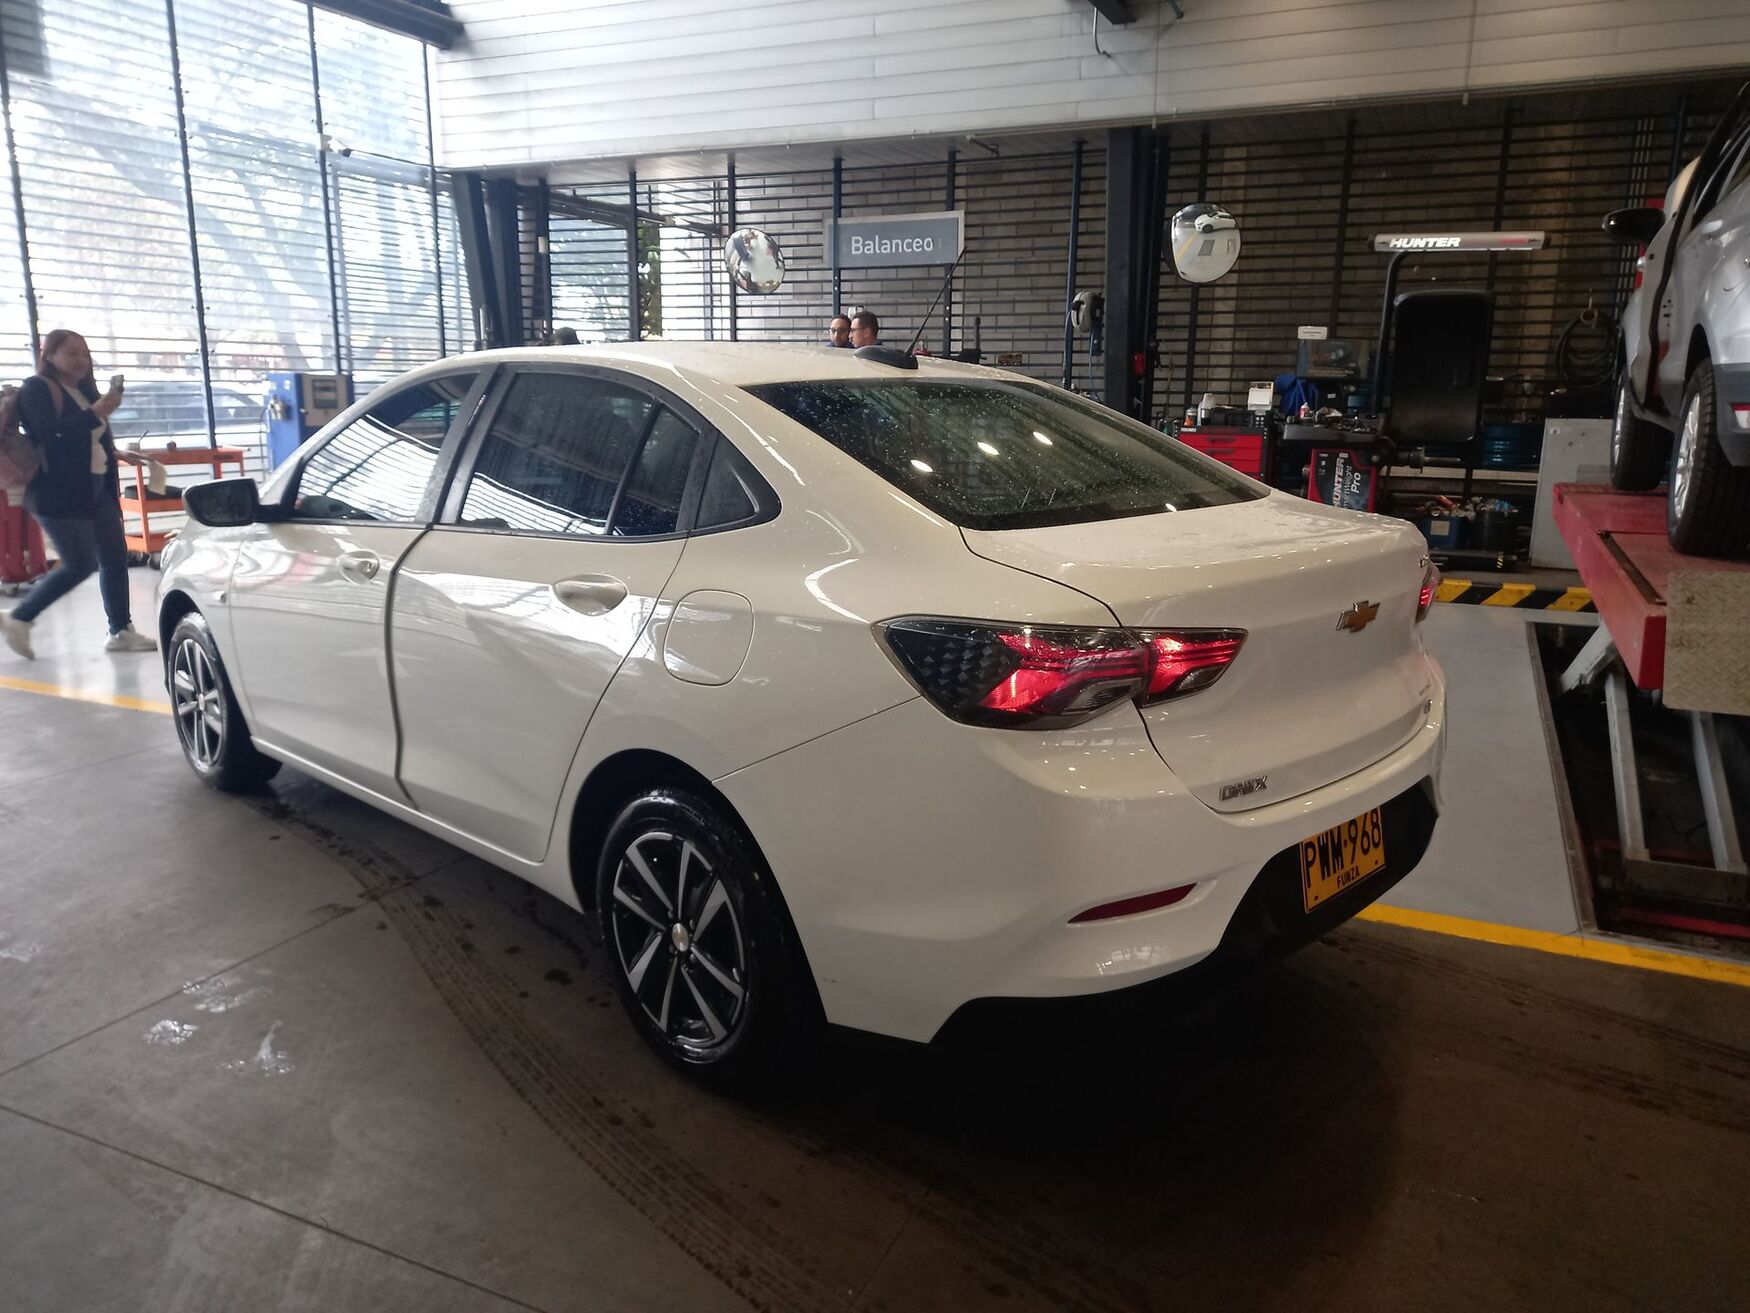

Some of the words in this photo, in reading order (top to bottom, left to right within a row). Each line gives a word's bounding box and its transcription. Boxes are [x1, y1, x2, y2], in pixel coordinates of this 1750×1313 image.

[851, 235, 933, 255] Balanceo
[1389, 237, 1461, 248] HUNTER
[1351, 472, 1361, 494] Pro
[1337, 865, 1360, 888] FUNZA
